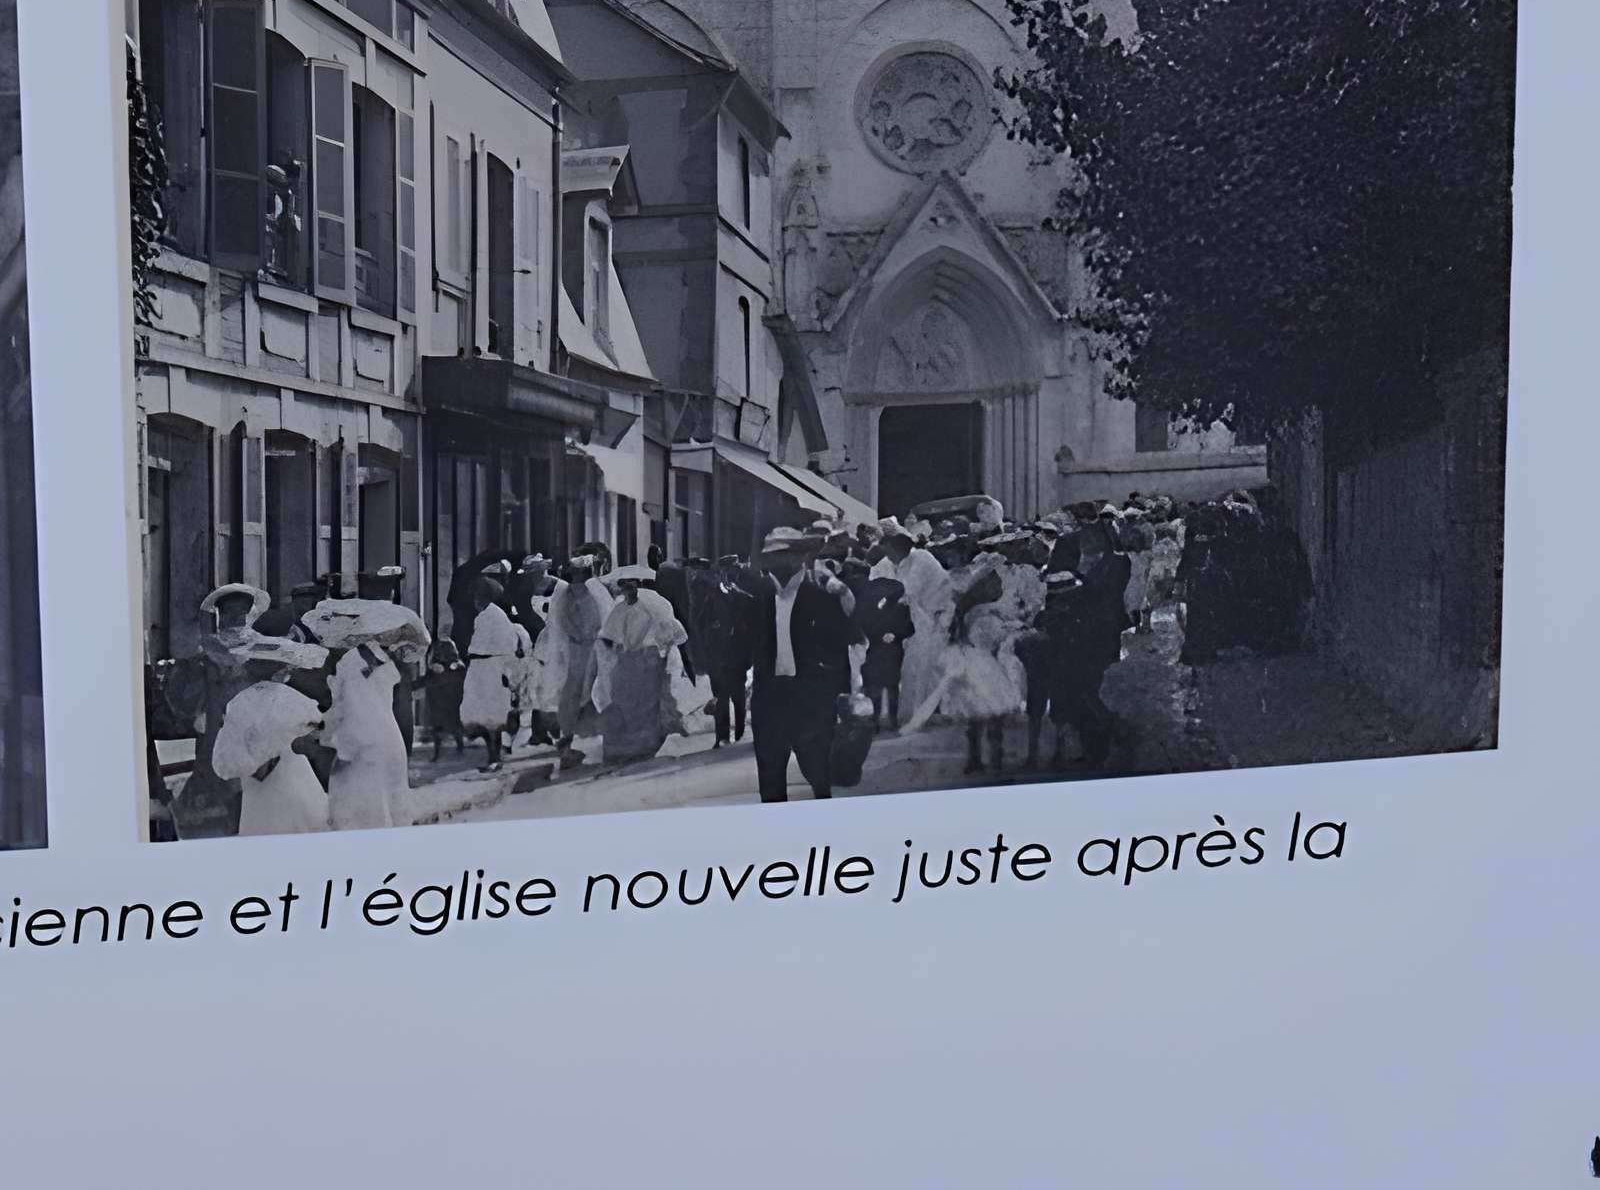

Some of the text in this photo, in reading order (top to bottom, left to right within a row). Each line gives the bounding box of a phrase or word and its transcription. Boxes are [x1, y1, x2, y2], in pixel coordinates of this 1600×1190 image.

[230, 882, 299, 934] et
[321, 870, 556, 935] l'église
[584, 845, 874, 912] nouvelle
[892, 834, 1051, 902] juste
[1078, 815, 1265, 885] après
[1288, 811, 1346, 861] la
